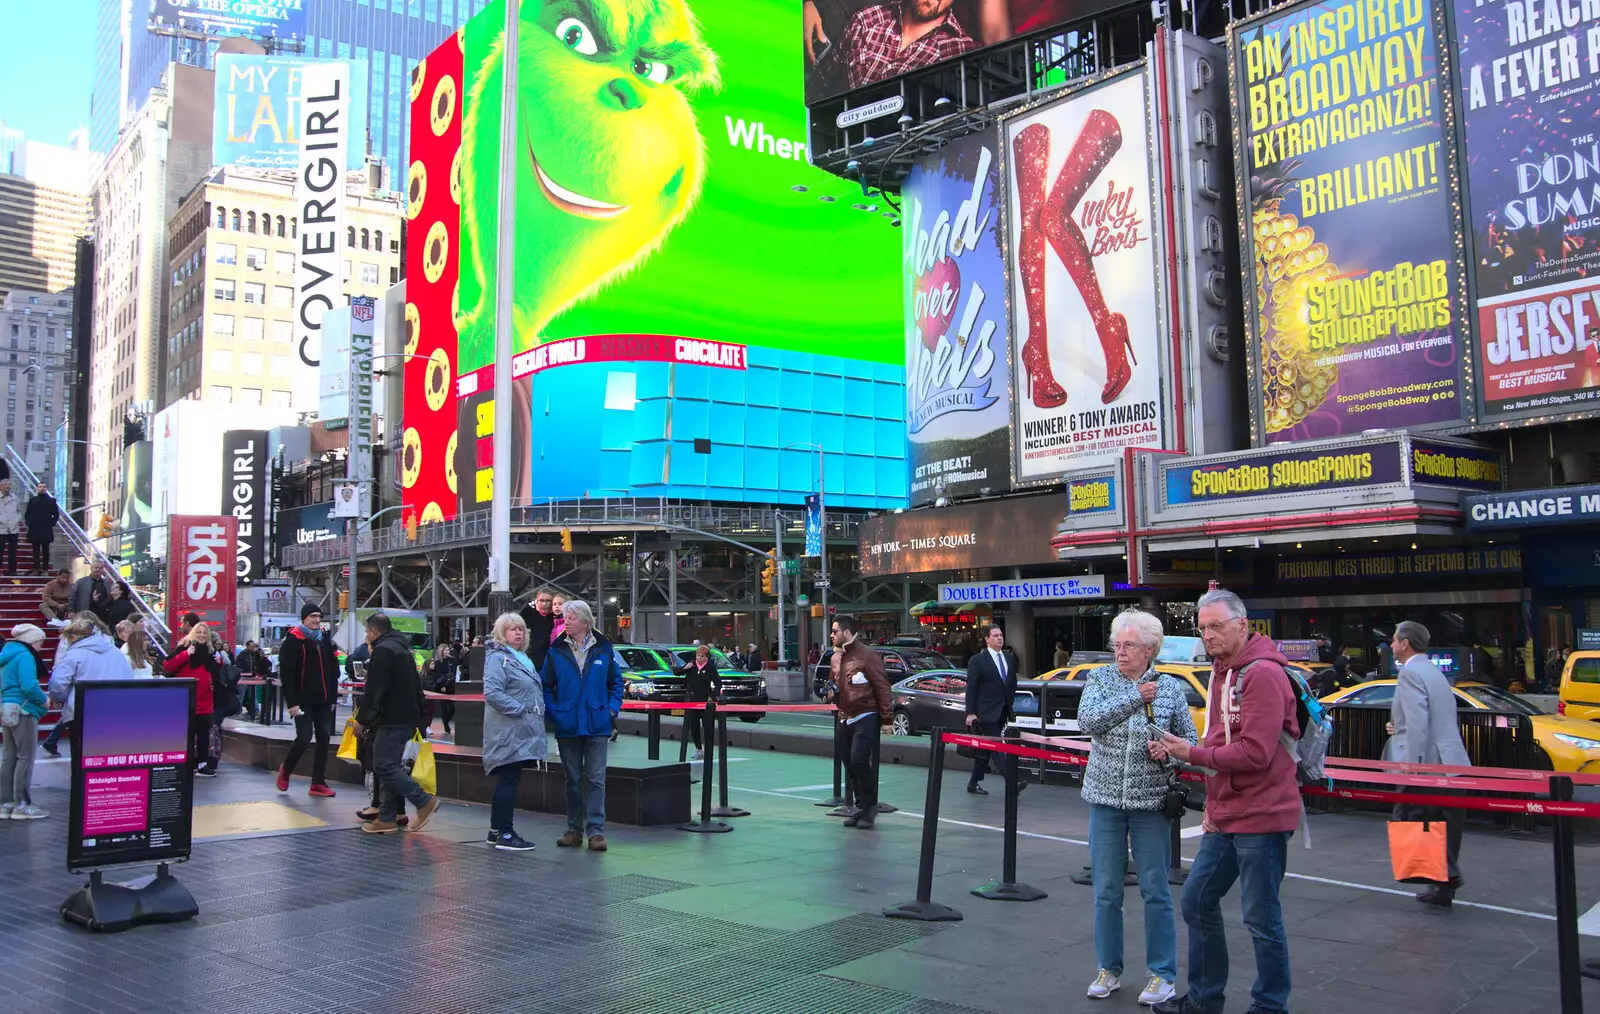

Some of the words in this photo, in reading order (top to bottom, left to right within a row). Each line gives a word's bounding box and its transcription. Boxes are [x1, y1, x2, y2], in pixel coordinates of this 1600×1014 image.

[232, 3, 289, 20] OPERA
[1289, 0, 1423, 68] INSPIRED
[228, 63, 278, 93] MY
[1249, 26, 1425, 132] BROADWAY
[1470, 65, 1487, 110] A
[1493, 35, 1580, 103] FEVER
[843, 112, 860, 123] city
[862, 101, 898, 117] outdoor
[1571, 133, 1594, 146] THE
[1190, 57, 1229, 362] PALACE
[1505, 182, 1600, 231] SUM
[299, 79, 340, 367] COVERGIRL
[1089, 217, 1148, 257] Boots
[1524, 265, 1581, 283] Lunt-Fontanne
[915, 280, 959, 321] over
[1308, 260, 1448, 325] SPONGEBOB
[354, 306, 372, 319] NFL
[1310, 298, 1451, 350] SQUAREPANTS
[549, 338, 585, 365] WORLD
[675, 338, 741, 367] CHOCOLATE
[1314, 358, 1326, 367] THE
[1326, 352, 1363, 365] BROADWAY
[1364, 344, 1400, 360] MUSICAL
[1401, 341, 1415, 352] FOR
[1415, 335, 1453, 350] EVERYONE
[1337, 378, 1454, 403] SpongeBobBroadway.com
[1499, 377, 1522, 389] BEST
[1524, 370, 1567, 386] MUSICAL
[935, 393, 976, 410] MUSICAL
[1347, 395, 1430, 414] @SpongeBobBway
[1515, 400, 1529, 409] New
[1530, 396, 1548, 406] World
[1549, 394, 1572, 405] Stages,
[1574, 392, 1586, 400] 340
[1024, 415, 1067, 439] WINNER!
[1070, 414, 1076, 432] 6
[1079, 408, 1107, 430] TONY
[1109, 400, 1156, 426] AWARDS
[1025, 434, 1071, 450] INCLUDING
[1073, 429, 1101, 442] BEST
[1104, 421, 1157, 438] MUSICAL
[1025, 445, 1086, 459] KINKYBOOTSTHEMUSICAL.COM
[1088, 443, 1097, 451] FOR
[1098, 440, 1115, 449] TICKETS
[1116, 438, 1127, 448] CALL
[916, 465, 926, 479] GET
[927, 461, 942, 475] THE
[943, 456, 972, 472] BEAT!
[1191, 465, 1269, 497] SPONGEBOB
[1271, 452, 1372, 488] SQUAREPANTS
[1414, 449, 1455, 477] SPONGEBOB
[1070, 481, 1109, 500] SPONGEBOB
[233, 440, 254, 583] OVERGIRL
[1471, 496, 1573, 521] CHANGE
[297, 529, 315, 544] Uber
[870, 543, 882, 555] NEW
[883, 541, 901, 553] YORK
[910, 537, 936, 549] TIMES
[939, 533, 977, 548] SQUARE
[186, 523, 227, 600] tkts
[1415, 551, 1482, 573] SEPTEMBER
[1485, 551, 1498, 568] 16
[1068, 586, 1100, 595] HILTON
[107, 755, 126, 766] NOW
[128, 754, 164, 764] PLAYING
[1526, 802, 1544, 812] tkts
